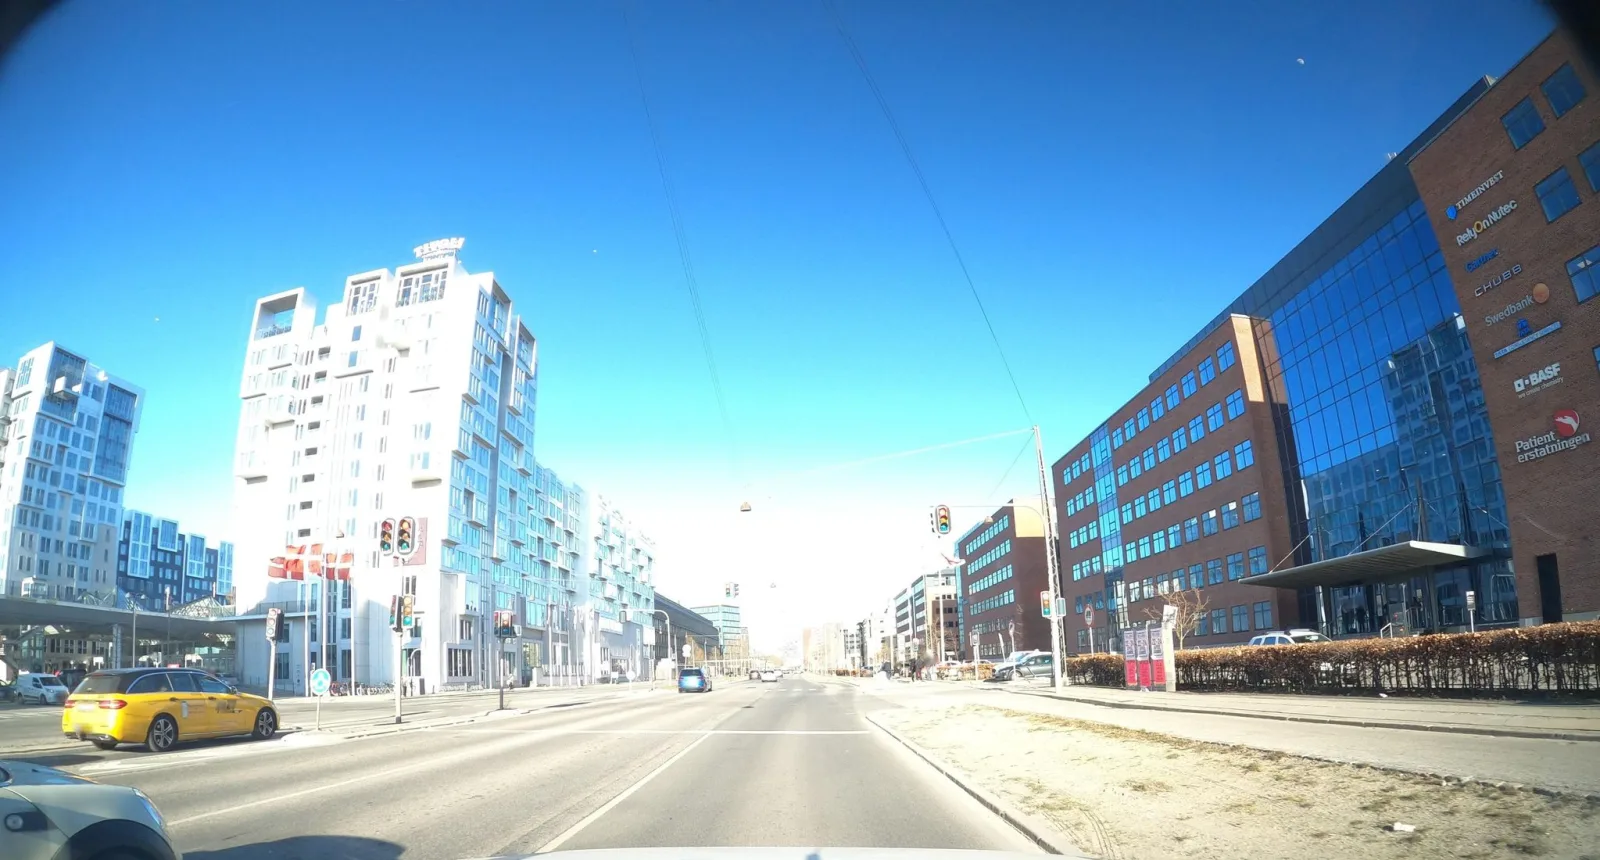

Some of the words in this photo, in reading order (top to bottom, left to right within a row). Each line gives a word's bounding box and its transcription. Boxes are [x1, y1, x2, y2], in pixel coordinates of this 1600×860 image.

[1455, 170, 1504, 209] TIMEINVEST
[1475, 265, 1522, 297] CHUBB
[1485, 294, 1534, 327] Swedbank
[1530, 363, 1561, 387] BASF
[1515, 431, 1556, 453] Patient
[1517, 432, 1591, 464] erstatningen
